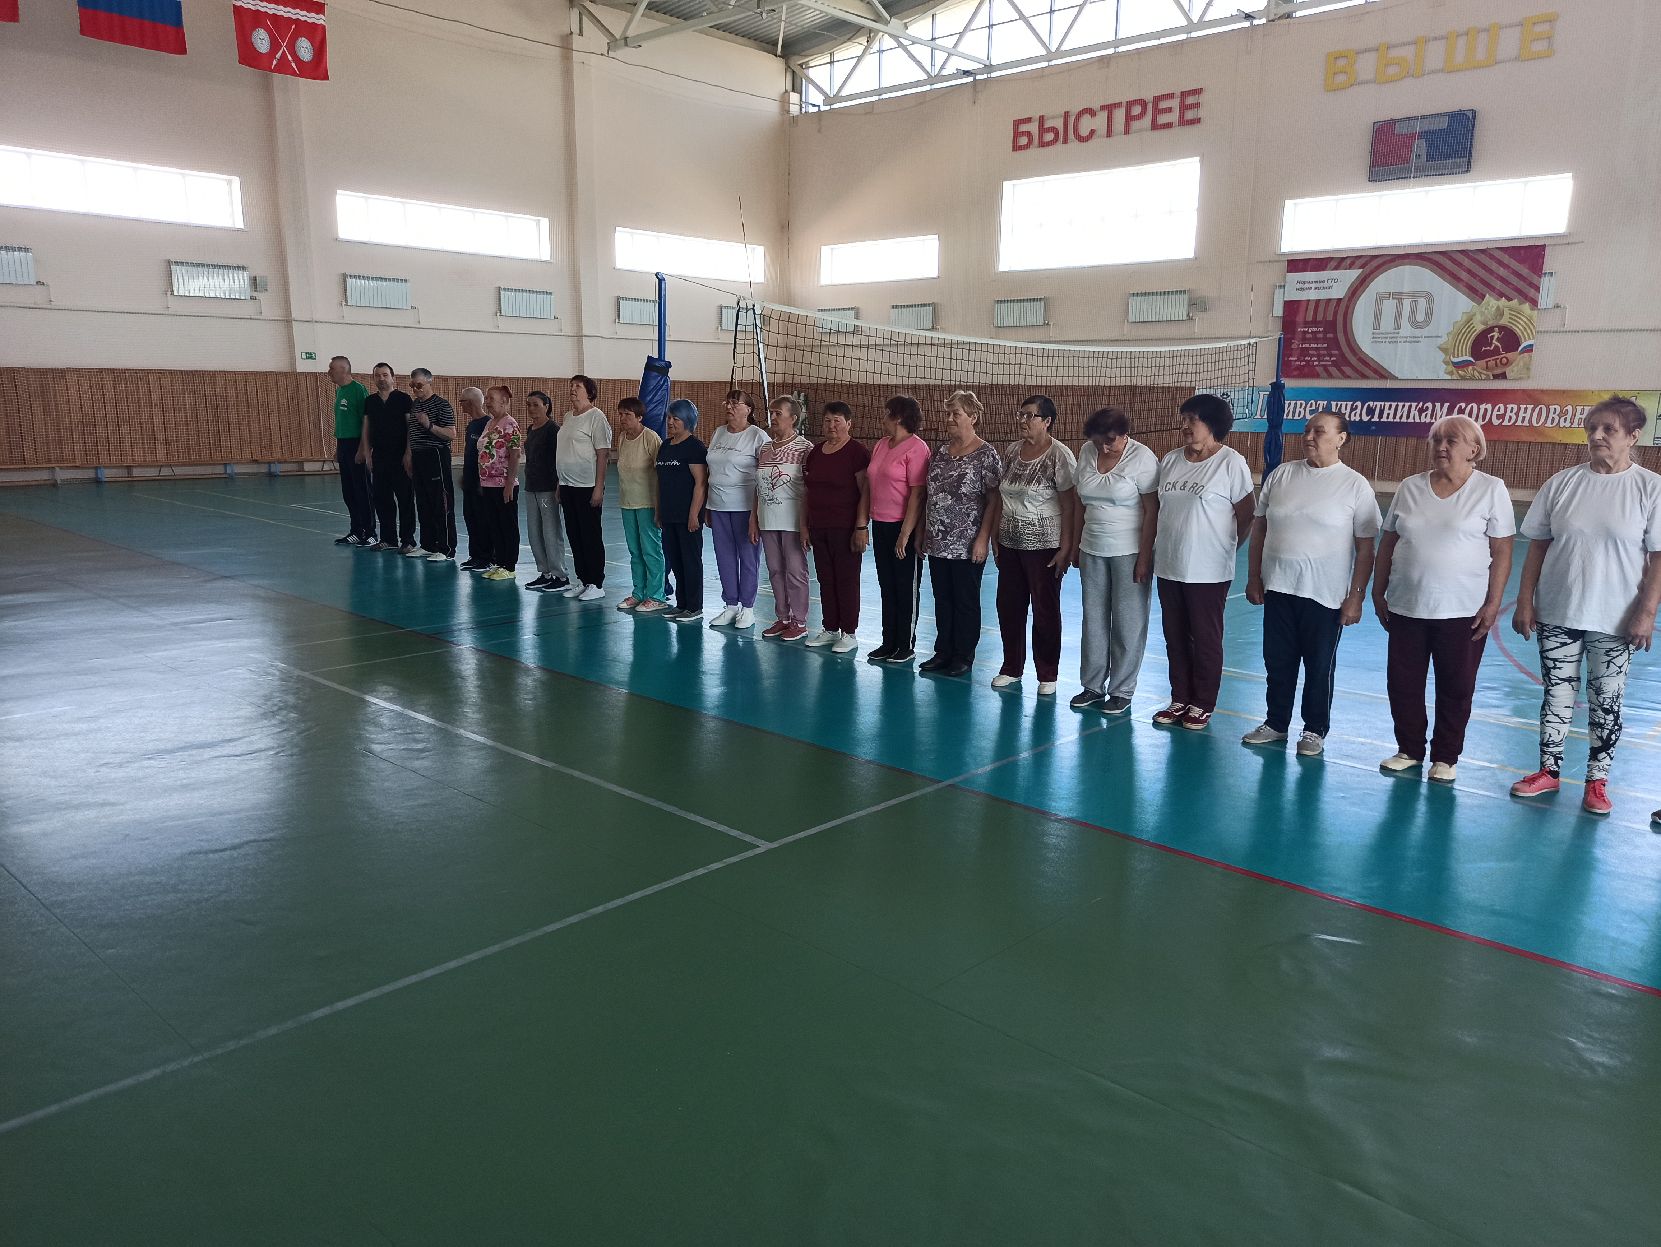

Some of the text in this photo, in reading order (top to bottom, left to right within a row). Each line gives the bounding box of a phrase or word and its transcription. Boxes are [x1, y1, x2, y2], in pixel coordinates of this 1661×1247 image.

[1324, 11, 1559, 93] ВЫШЕ
[1012, 87, 1203, 152] БЫСТРЕЕ
[1372, 290, 1435, 331] ГТО
[1484, 356, 1510, 370] ГТО
[1253, 391, 1328, 421] Пивет
